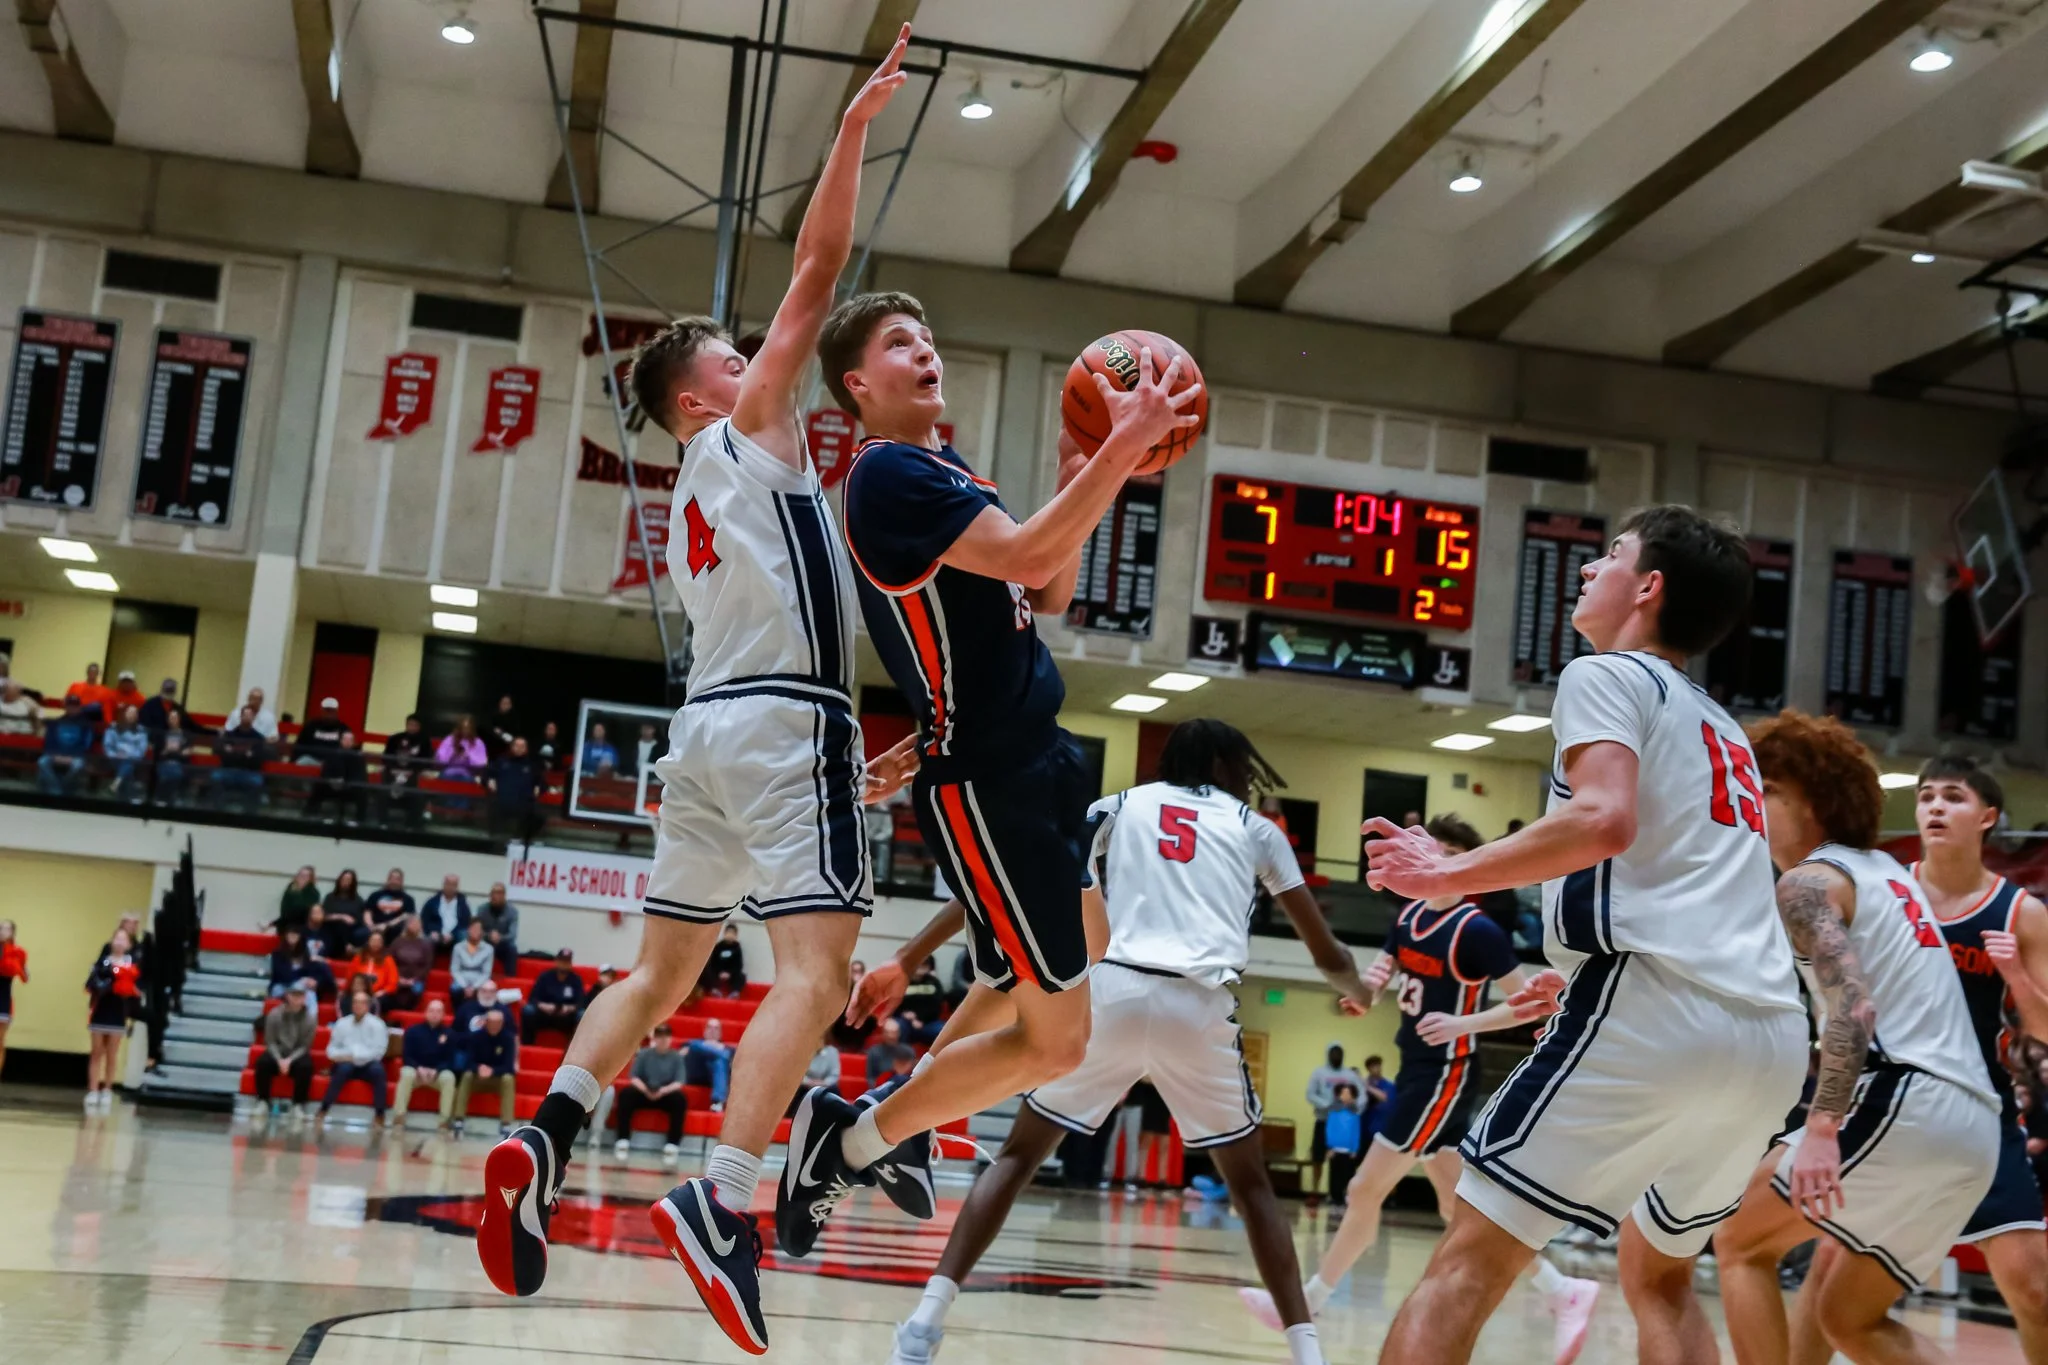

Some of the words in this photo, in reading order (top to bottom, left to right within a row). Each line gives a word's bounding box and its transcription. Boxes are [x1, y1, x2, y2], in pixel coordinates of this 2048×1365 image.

[1256, 505, 1278, 545] 7
[1334, 493, 1402, 536] 1:04
[683, 494, 722, 580] 4
[1437, 530, 1470, 570] 15
[1384, 548, 1395, 576] 1
[1265, 571, 1276, 600] 1
[1414, 589, 1434, 620] 2
[1701, 720, 1766, 839] 15
[1157, 803, 1199, 864] 5
[509, 859, 627, 899] IHSAA-SCHOOL
[634, 872, 650, 900] O
